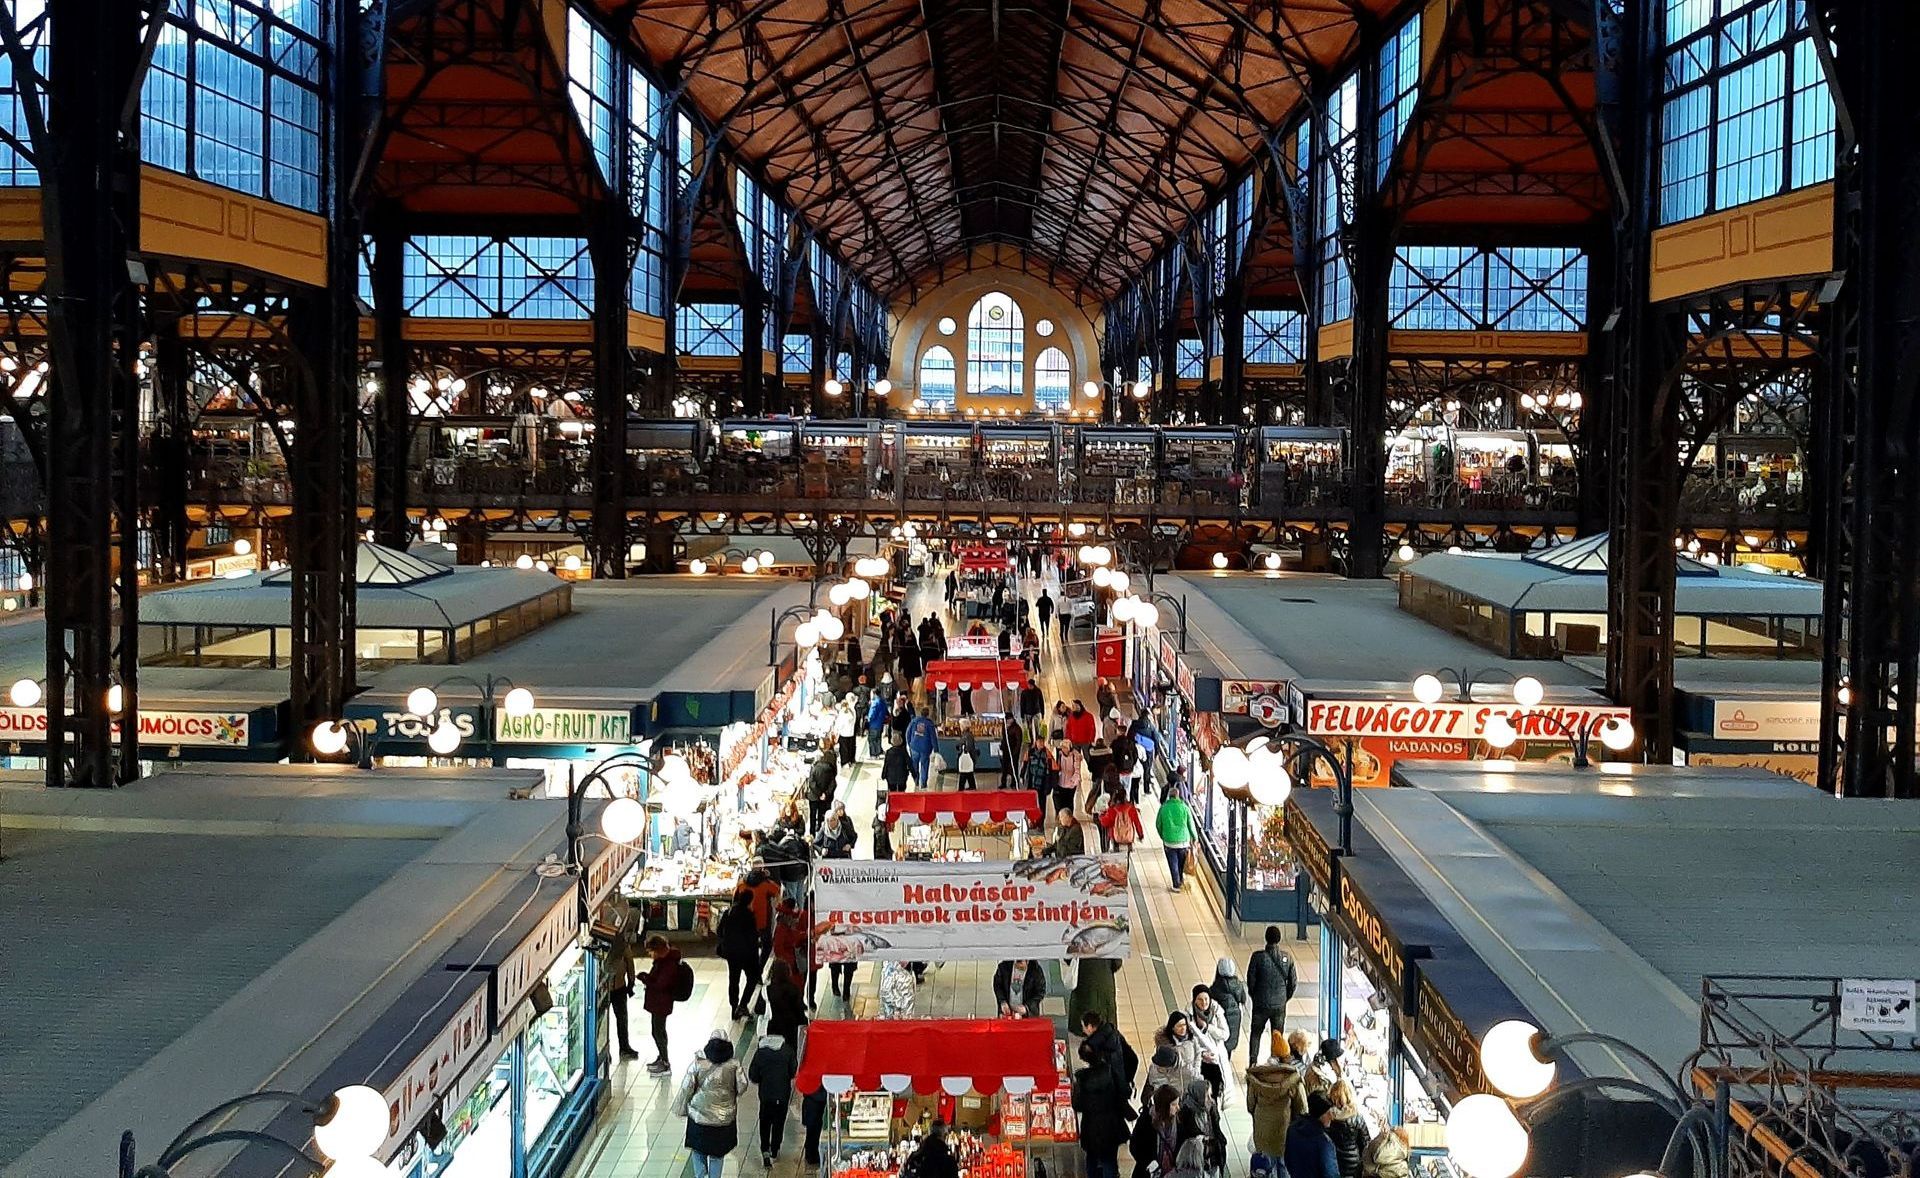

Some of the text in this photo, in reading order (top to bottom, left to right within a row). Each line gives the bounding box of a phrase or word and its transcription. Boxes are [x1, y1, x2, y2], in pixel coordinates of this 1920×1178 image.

[501, 711, 596, 740] AGRO-FRUIT
[1310, 703, 1630, 737] FELVÁGOTT SAKÜZLE
[1389, 740, 1463, 754] KABANOS
[834, 867, 899, 877] BUDAPEST
[903, 880, 1035, 905] Halvásár
[828, 900, 1115, 926] a csarnok alsó szintjén.
[1340, 877, 1404, 987] CSOKIBOLT
